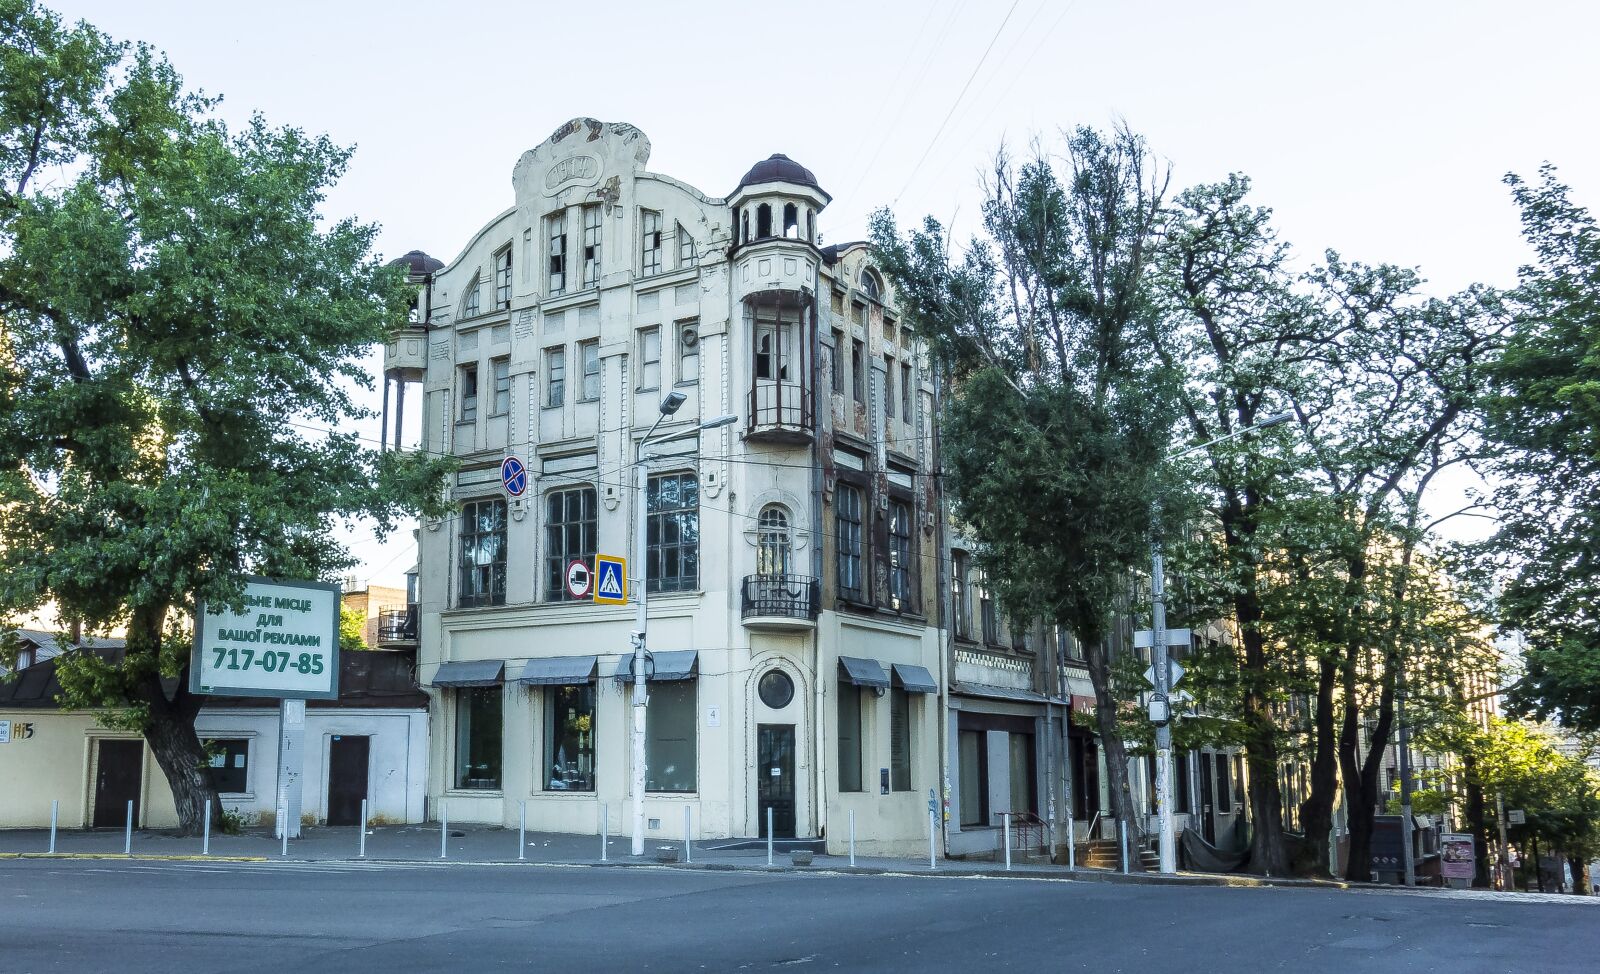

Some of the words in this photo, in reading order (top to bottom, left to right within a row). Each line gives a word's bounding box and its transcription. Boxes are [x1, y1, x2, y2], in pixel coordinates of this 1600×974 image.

[275, 597, 312, 613] МІСЦЕ
[256, 614, 283, 627] ДЛЯ
[218, 628, 262, 643] ВАШОЇ
[263, 631, 321, 647] РЕКЛАМИ
[212, 647, 324, 675] 717-07-85
